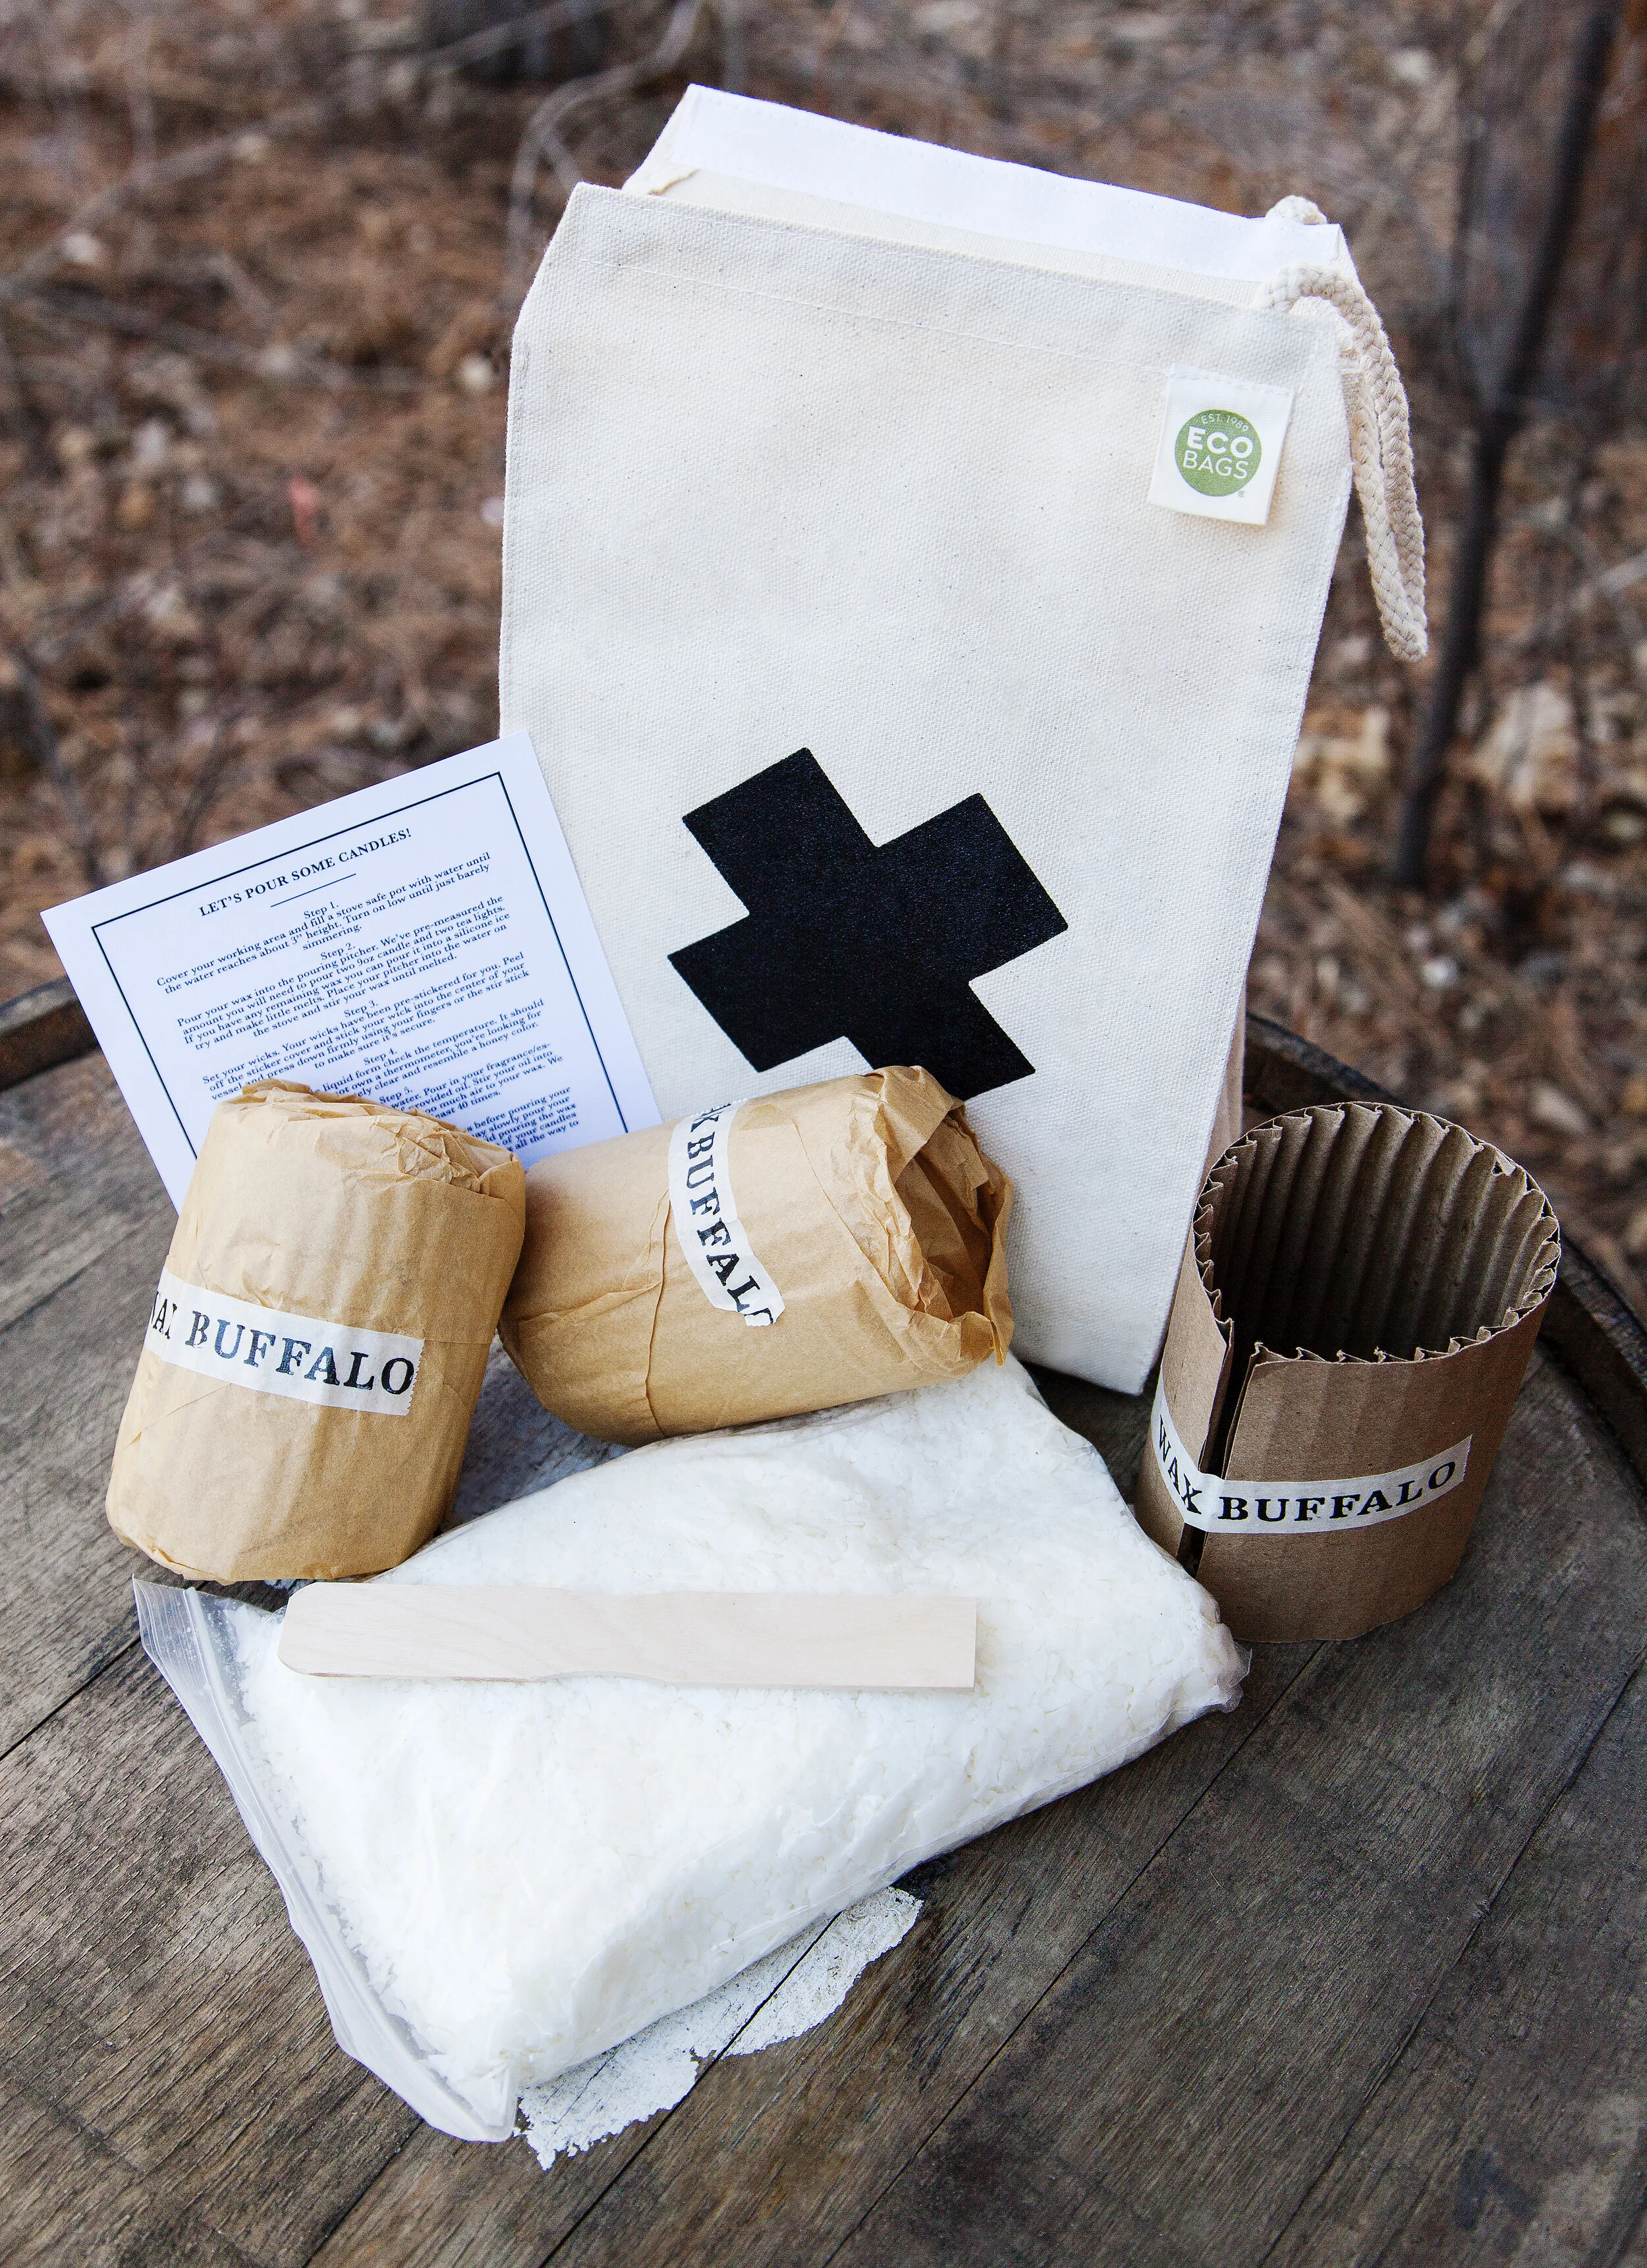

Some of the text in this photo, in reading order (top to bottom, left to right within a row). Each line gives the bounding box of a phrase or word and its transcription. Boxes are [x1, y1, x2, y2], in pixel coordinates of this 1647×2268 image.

[1186, 425, 1254, 459] ECO
[1225, 414, 1250, 432] 1989
[1183, 449, 1250, 480] BAGS
[243, 875, 290, 899] POUR
[291, 856, 336, 882] SOME
[337, 827, 412, 863] CANDLES!
[156, 851, 491, 987] Cover your working area and fill stove safe pot with water until
[164, 863, 490, 995] the water reaches about height. Turn low until just barely
[302, 906, 328, 920] Step
[302, 923, 362, 951] simmering.
[177, 1012, 203, 1027] Pour
[204, 1002, 229, 1019] your
[230, 992, 254, 1006] wax
[253, 984, 276, 998] into
[277, 977, 295, 988] the
[296, 959, 339, 983] pouring
[339, 944, 379, 967] pitcher.
[412, 900, 486, 938] pre-measured
[486, 895, 504, 907] the
[182, 905, 506, 1036] amount you will need pour two 9oz candle and two tea lights.
[196, 913, 511, 1042] you have any remaining wax you can pour into silicone ice
[320, 947, 345, 961] Step
[194, 929, 492, 1051] try and make little melts. Place your pitcher into the water
[221, 950, 525, 1079] your wicks. Your wicks have been pre-stickered you. Peel
[245, 962, 525, 1077] sticker cover stick your wick into center your
[252, 951, 458, 1038] the stove stir your until melted.
[343, 1005, 368, 1019] Step
[211, 969, 530, 1101] vessel press down firmly using your fingers stir stick
[321, 1073, 354, 1092] liquid
[354, 1064, 382, 1079] form
[383, 1050, 413, 1068] check
[432, 1019, 498, 1048] temperature.
[509, 997, 545, 1018] should
[326, 1048, 356, 1065] make
[356, 1038, 381, 1053] sure
[399, 1018, 436, 1035] secure.
[362, 1053, 387, 1066] Step
[374, 1021, 539, 1091] clear resemble honey color.
[382, 1046, 453, 1078] thermometer,
[486, 1016, 526, 1036] looking
[378, 1091, 403, 1106] Step
[389, 1093, 422, 1110] water.
[422, 1082, 447, 1097] Pour
[461, 1067, 484, 1085] your
[437, 1063, 546, 1110] much your wax.
[454, 1081, 471, 1094] oil.
[471, 1073, 491, 1087] Stir
[493, 1064, 516, 1081] your
[532, 1050, 553, 1063] into
[470, 1090, 501, 1106] times.
[184, 1310, 415, 1396] BUFFALO
[1158, 1414, 1456, 1522] WAX BUFFALO
